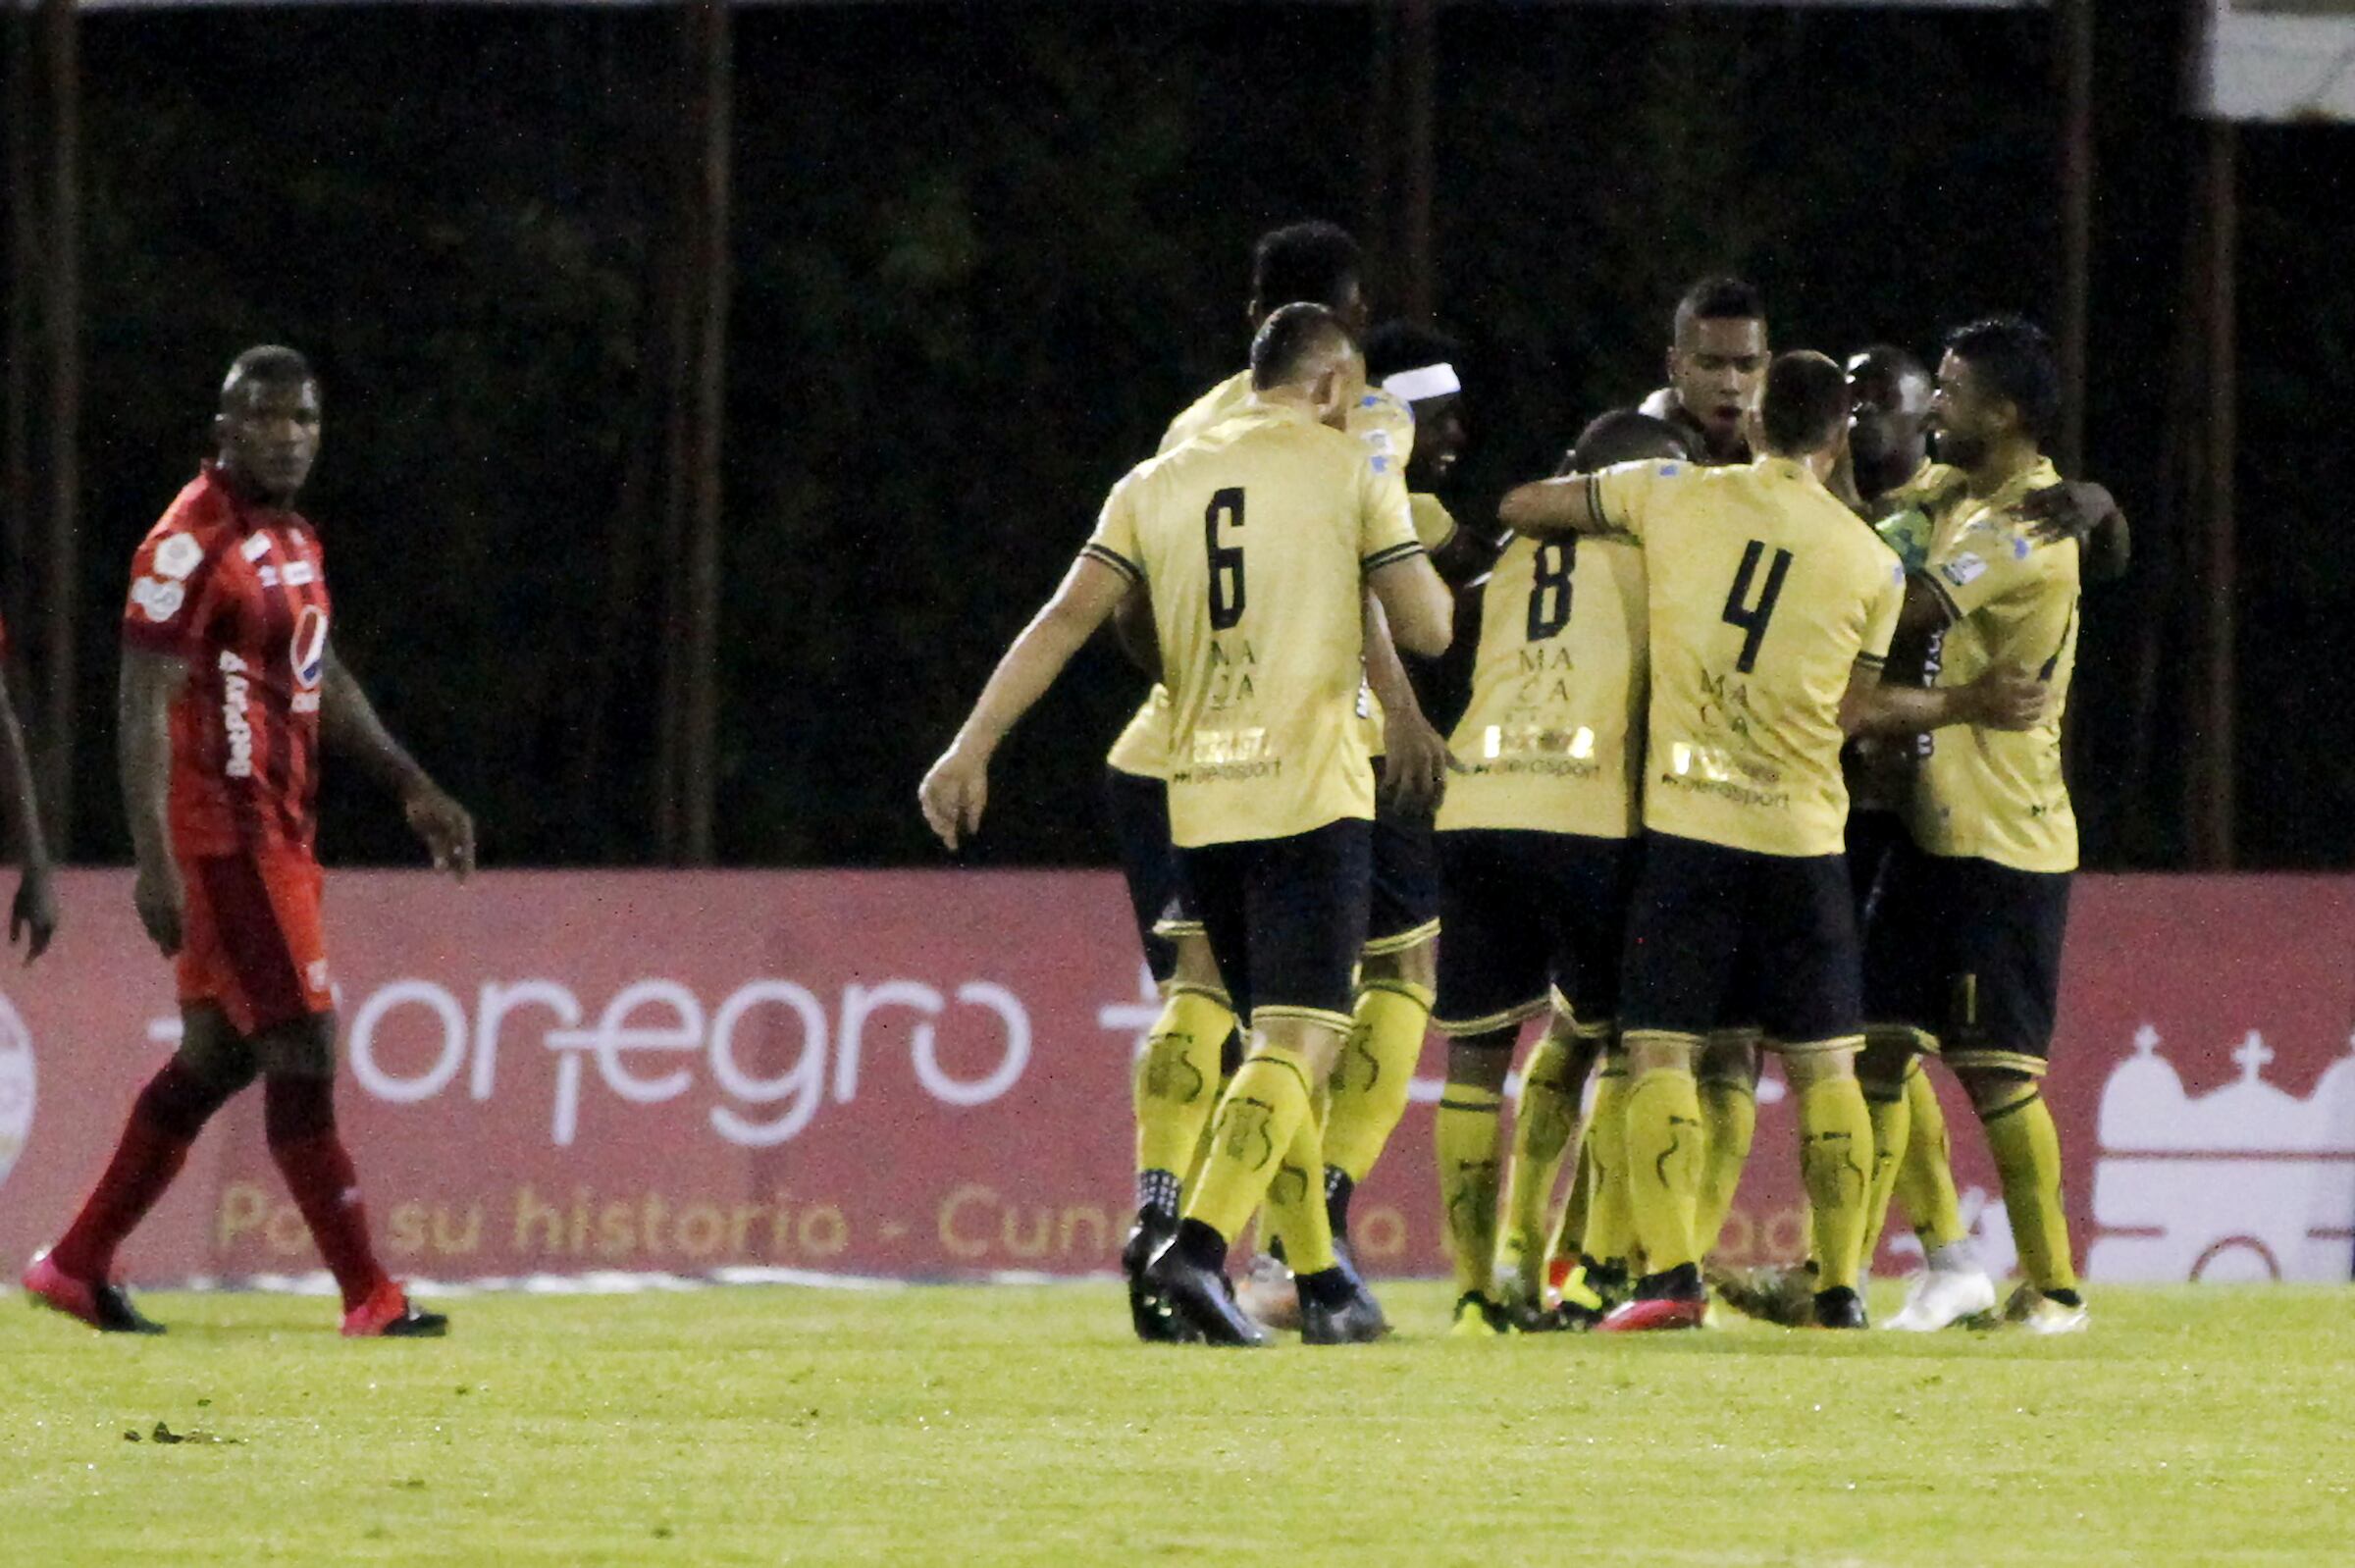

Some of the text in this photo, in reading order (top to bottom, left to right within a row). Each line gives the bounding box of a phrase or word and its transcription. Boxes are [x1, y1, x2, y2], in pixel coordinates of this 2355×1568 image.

[1205, 487, 1245, 632] 6
[1527, 540, 1577, 642] 8
[1722, 540, 1795, 674] 4
[147, 977, 1032, 1147] onegro
[221, 1183, 343, 1255] Po
[392, 1203, 483, 1256] su
